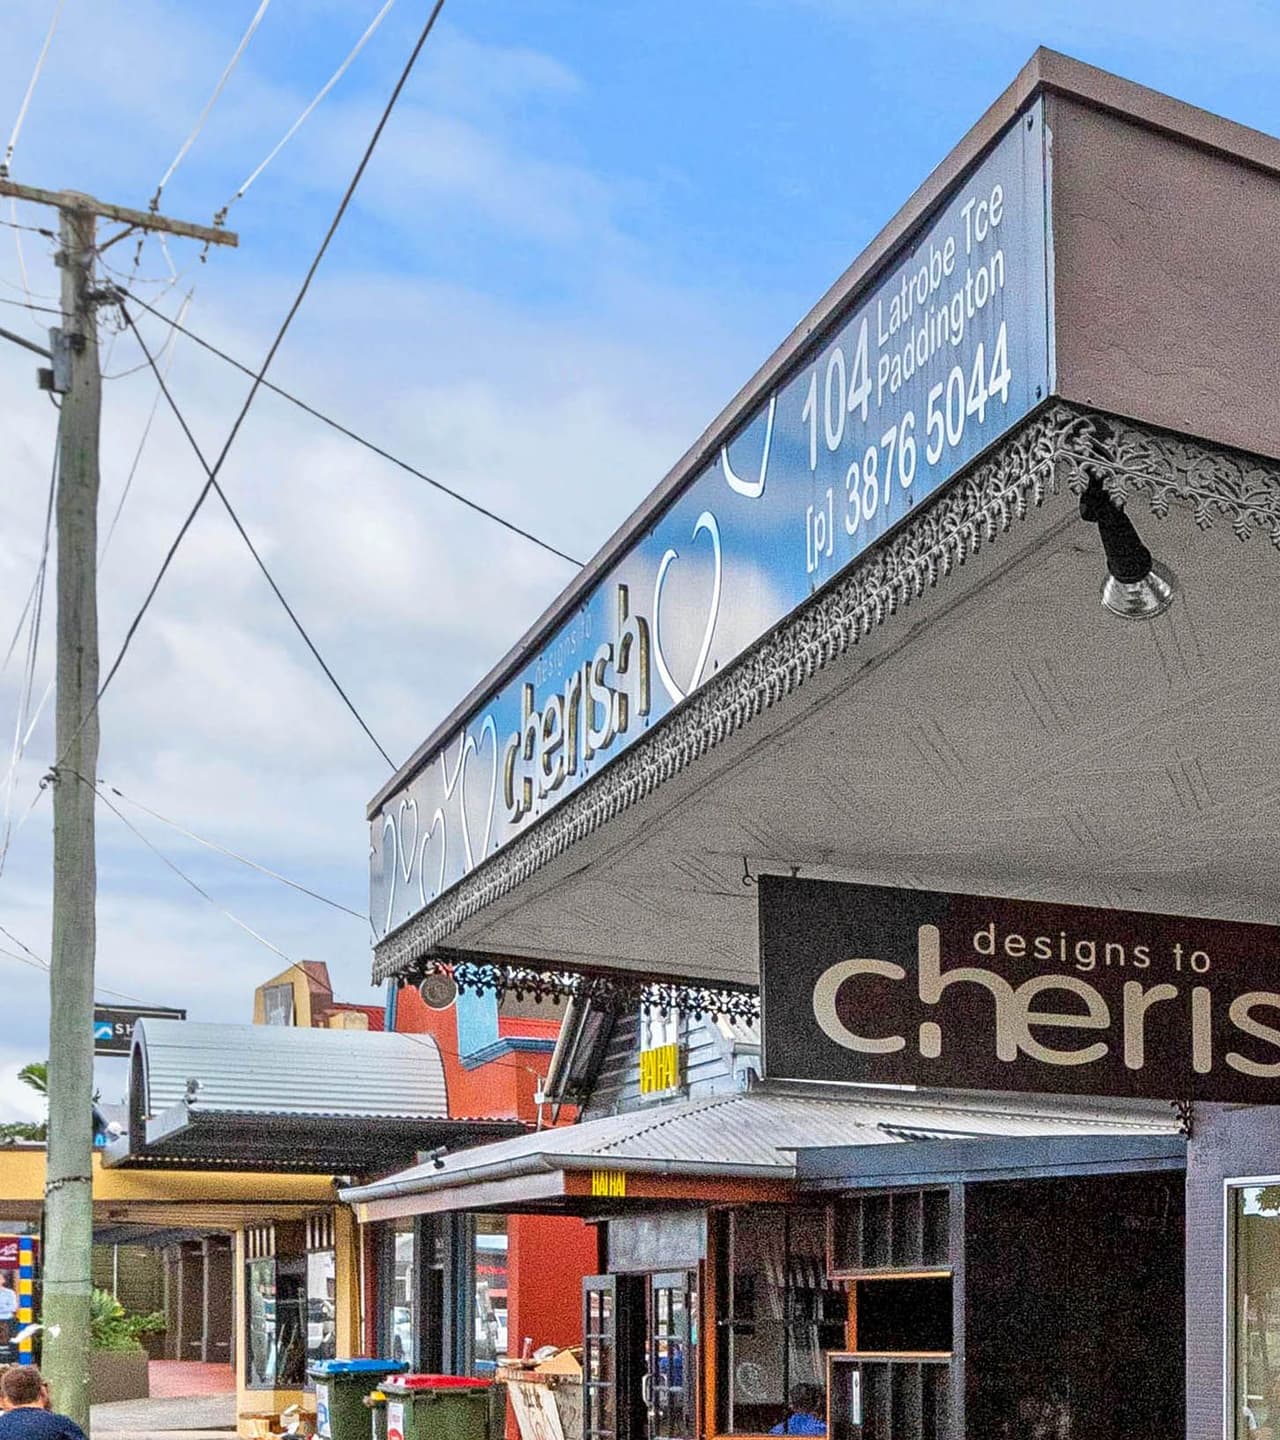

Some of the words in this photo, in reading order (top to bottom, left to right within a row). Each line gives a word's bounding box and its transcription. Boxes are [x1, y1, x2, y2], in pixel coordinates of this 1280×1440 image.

[801, 317, 872, 471] 104
[877, 235, 955, 347] Latrobe
[960, 184, 1004, 256] Tce
[845, 410, 916, 536] 3876
[926, 321, 1012, 466] 5044
[877, 249, 1005, 408] Paddington
[504, 583, 651, 824] cherish
[973, 923, 1151, 970] designs
[1173, 942, 1212, 973] to
